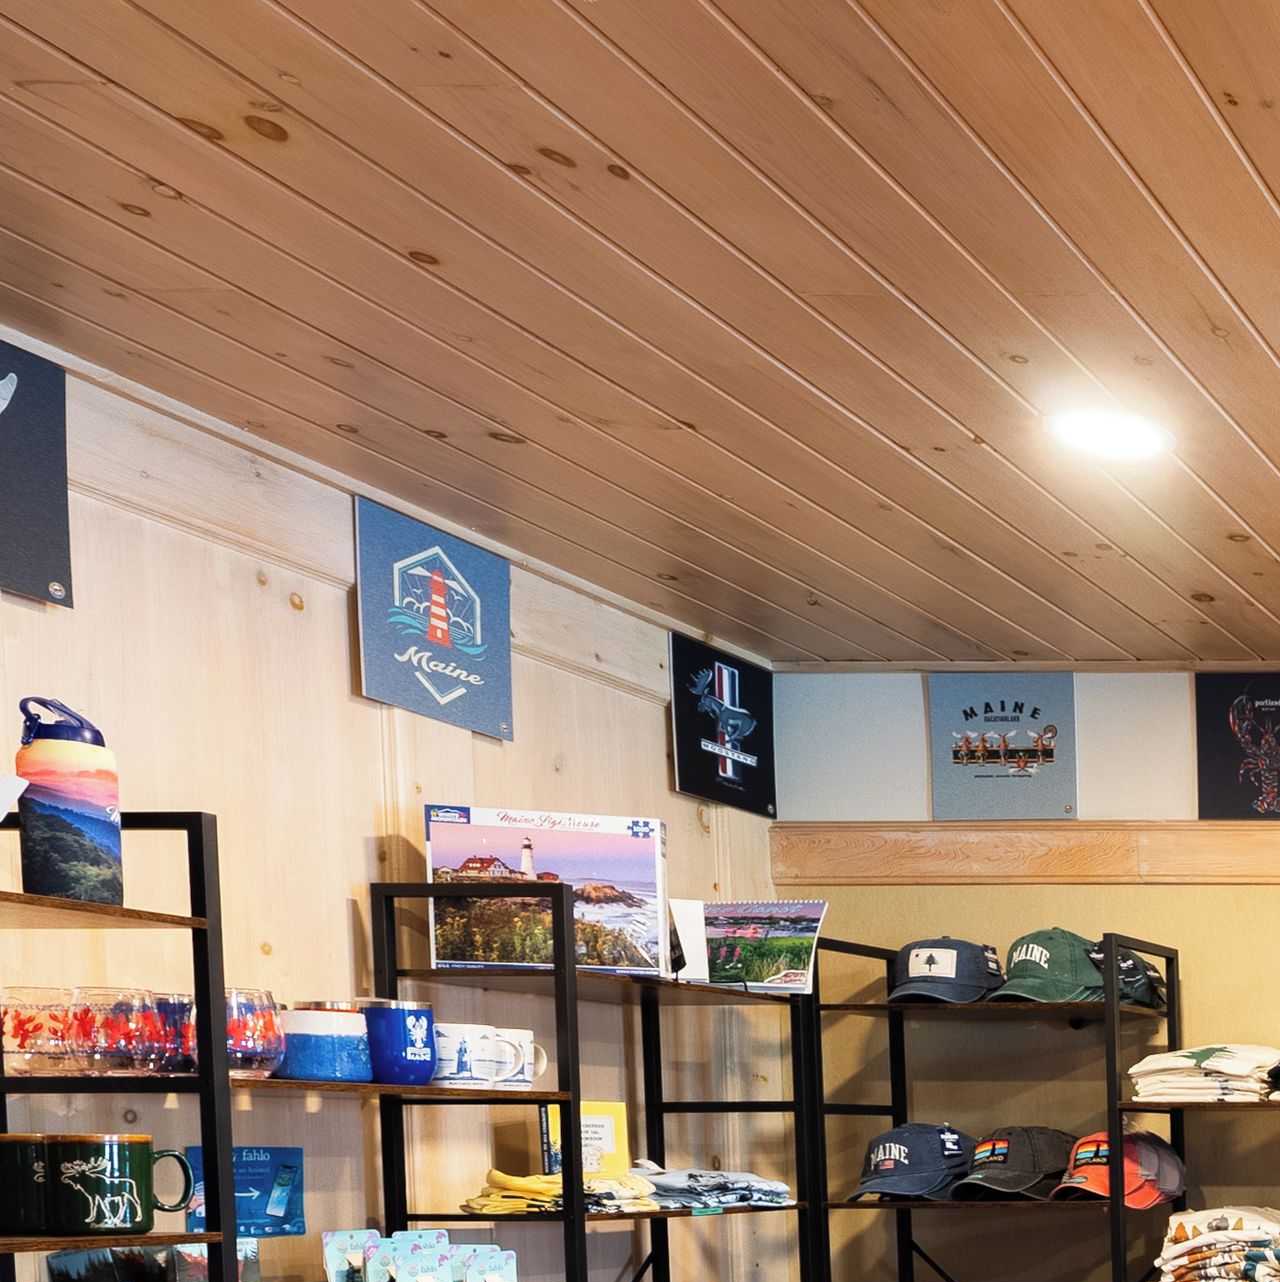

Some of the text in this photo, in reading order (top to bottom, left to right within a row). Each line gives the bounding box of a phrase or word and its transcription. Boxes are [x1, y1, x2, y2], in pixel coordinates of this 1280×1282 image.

[394, 645, 485, 686] Maine
[962, 700, 1042, 721] MAINE
[1011, 944, 1050, 969] MAINE
[242, 1149, 271, 1161] fahlo
[870, 1143, 908, 1170] MAINE
